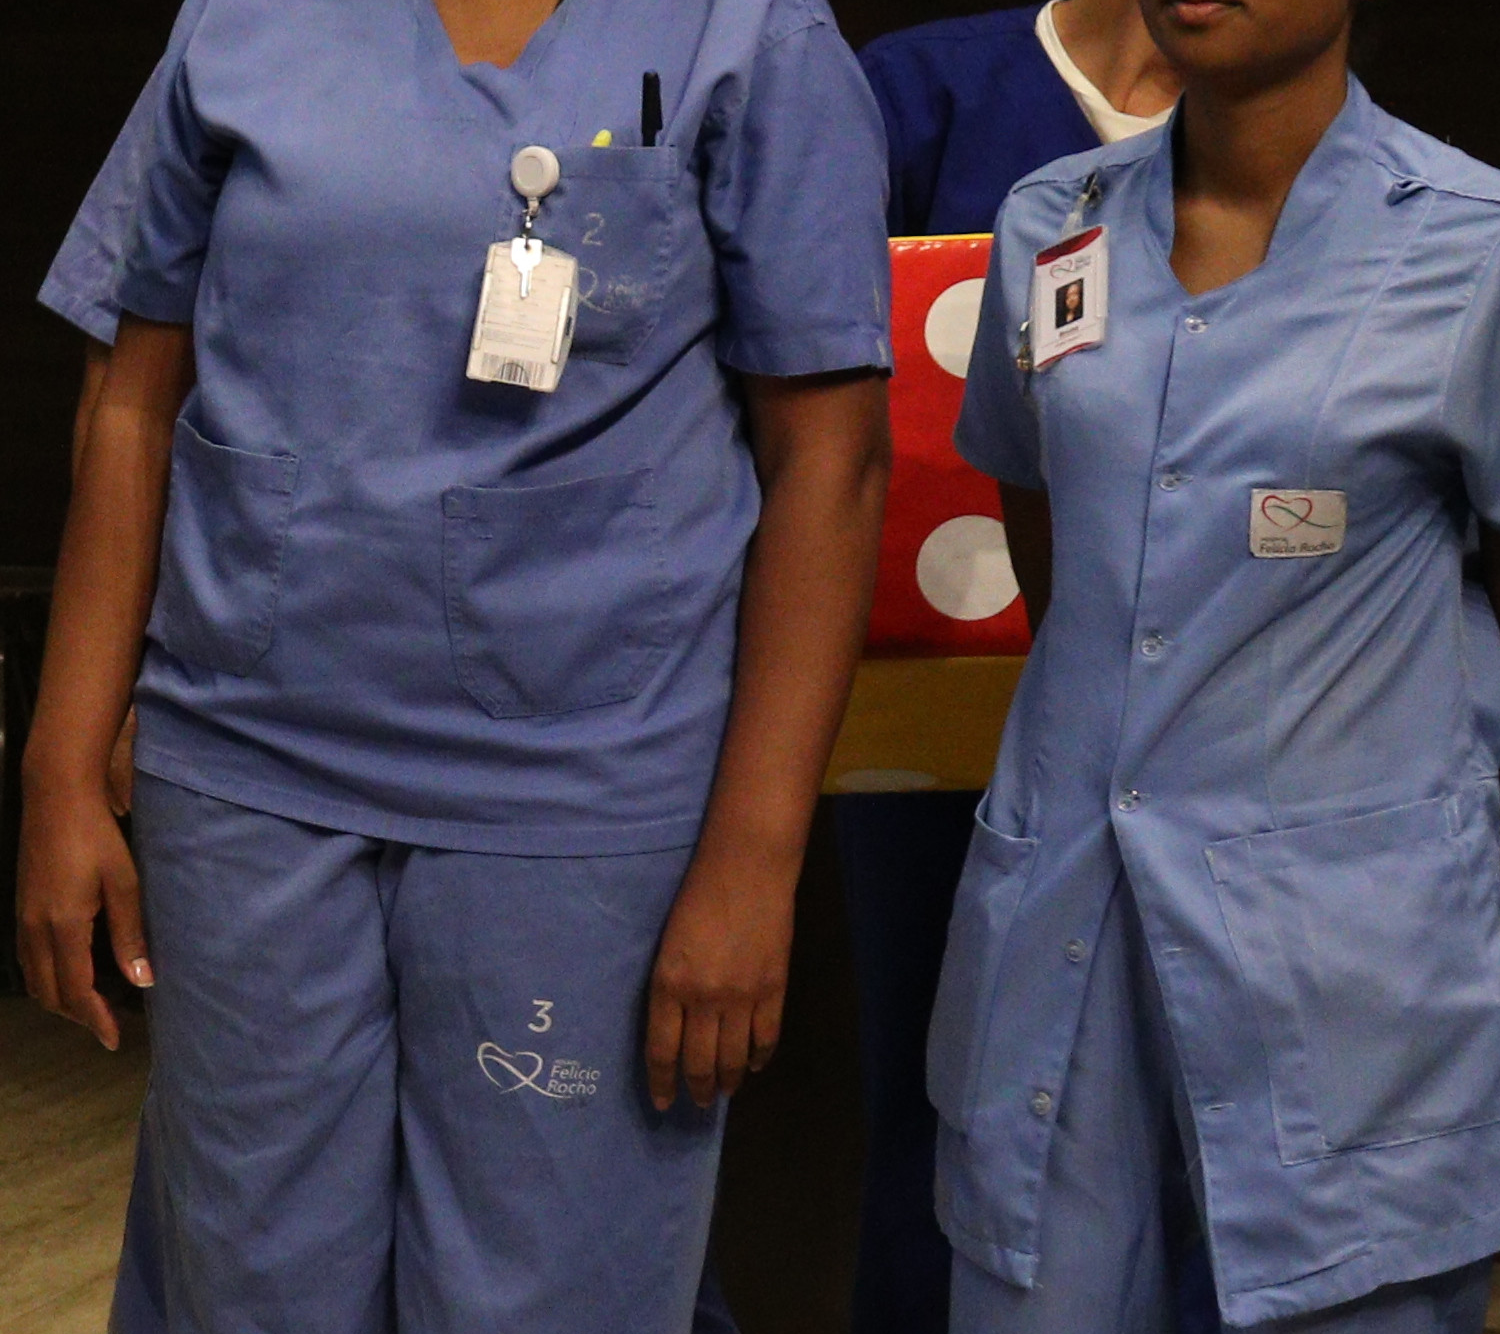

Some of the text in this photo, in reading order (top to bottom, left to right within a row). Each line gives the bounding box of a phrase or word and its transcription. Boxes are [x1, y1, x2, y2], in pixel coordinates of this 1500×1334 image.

[581, 213, 606, 247] 2
[528, 999, 553, 1032] 3
[547, 1079, 597, 1095] Rocho
